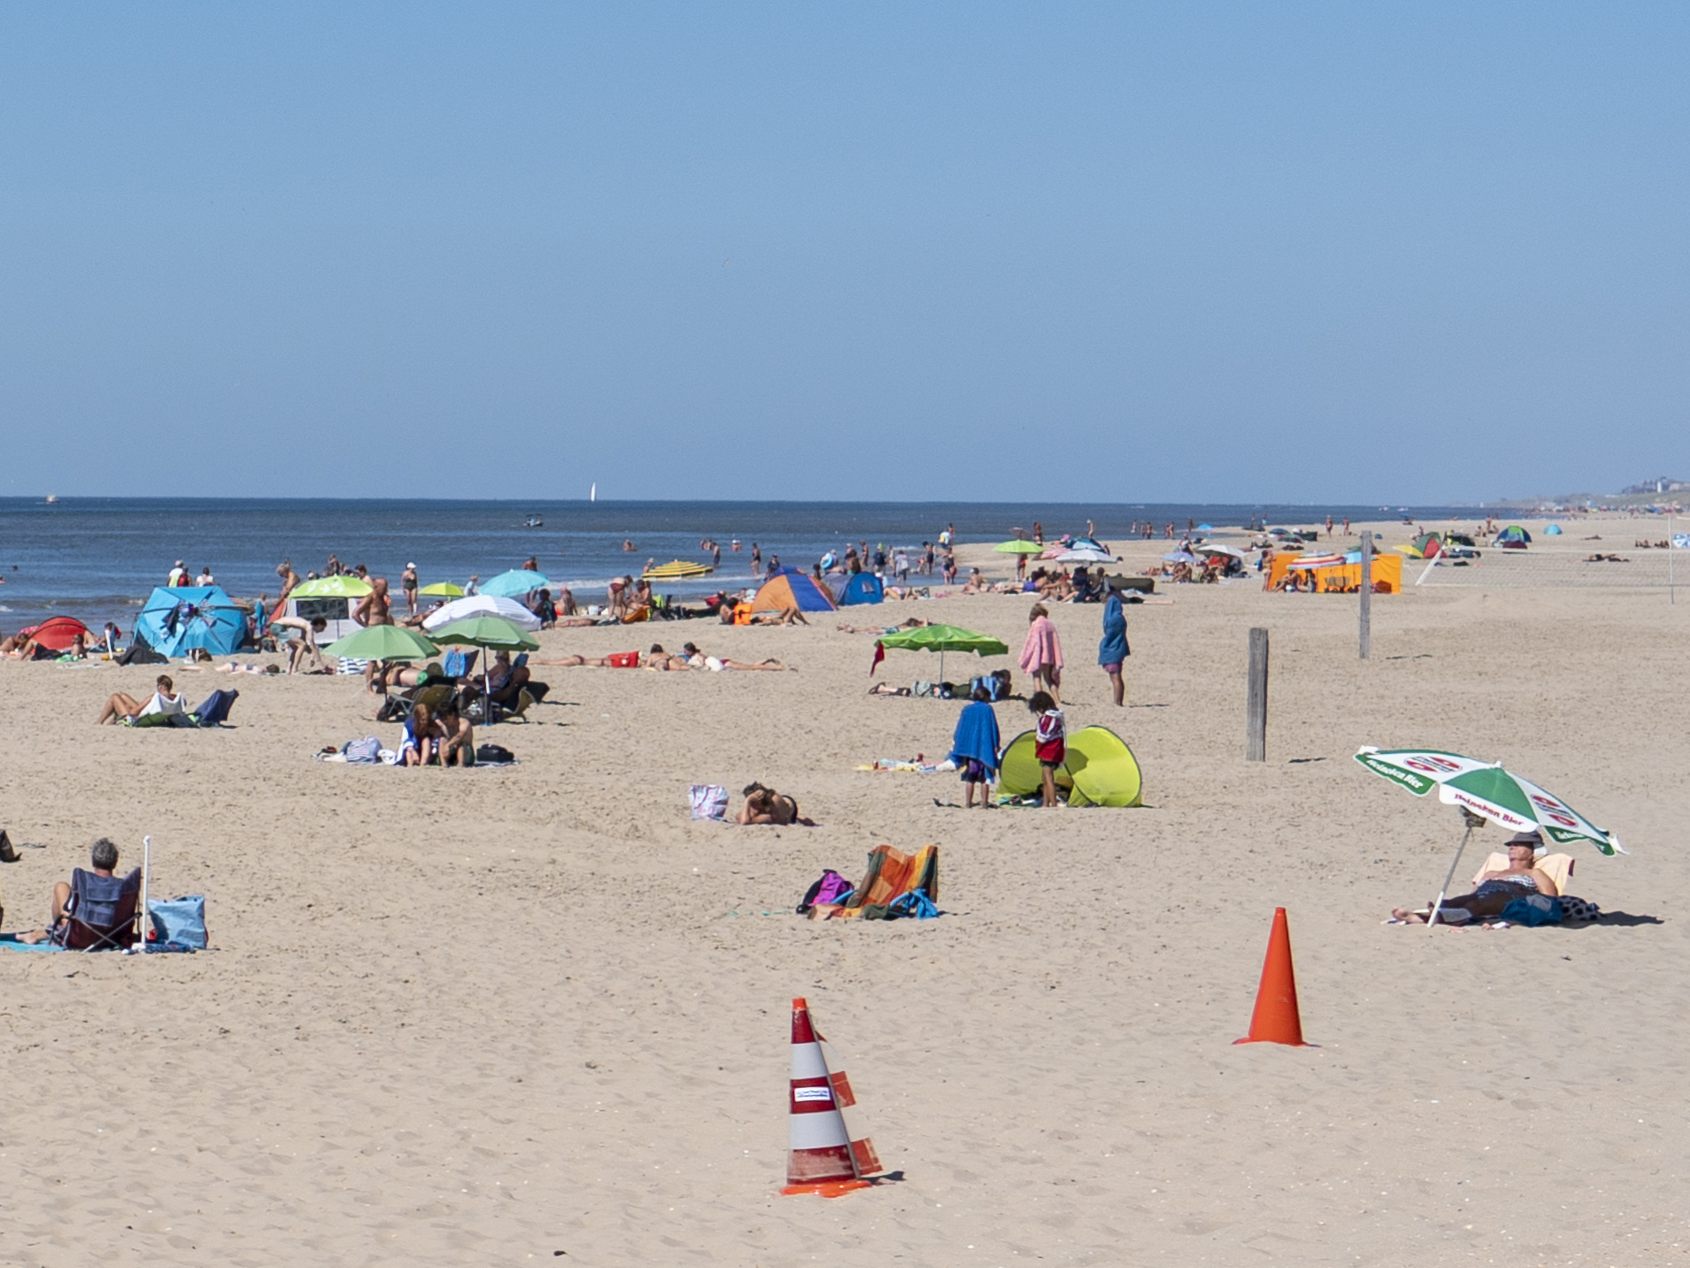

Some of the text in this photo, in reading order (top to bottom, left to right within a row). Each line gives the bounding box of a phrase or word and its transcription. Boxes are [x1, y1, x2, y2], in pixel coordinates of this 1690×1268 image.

[1366, 759, 1406, 780] Heineken
[1403, 774, 1424, 789] Bier
[1454, 793, 1525, 827] Heineken Bier
